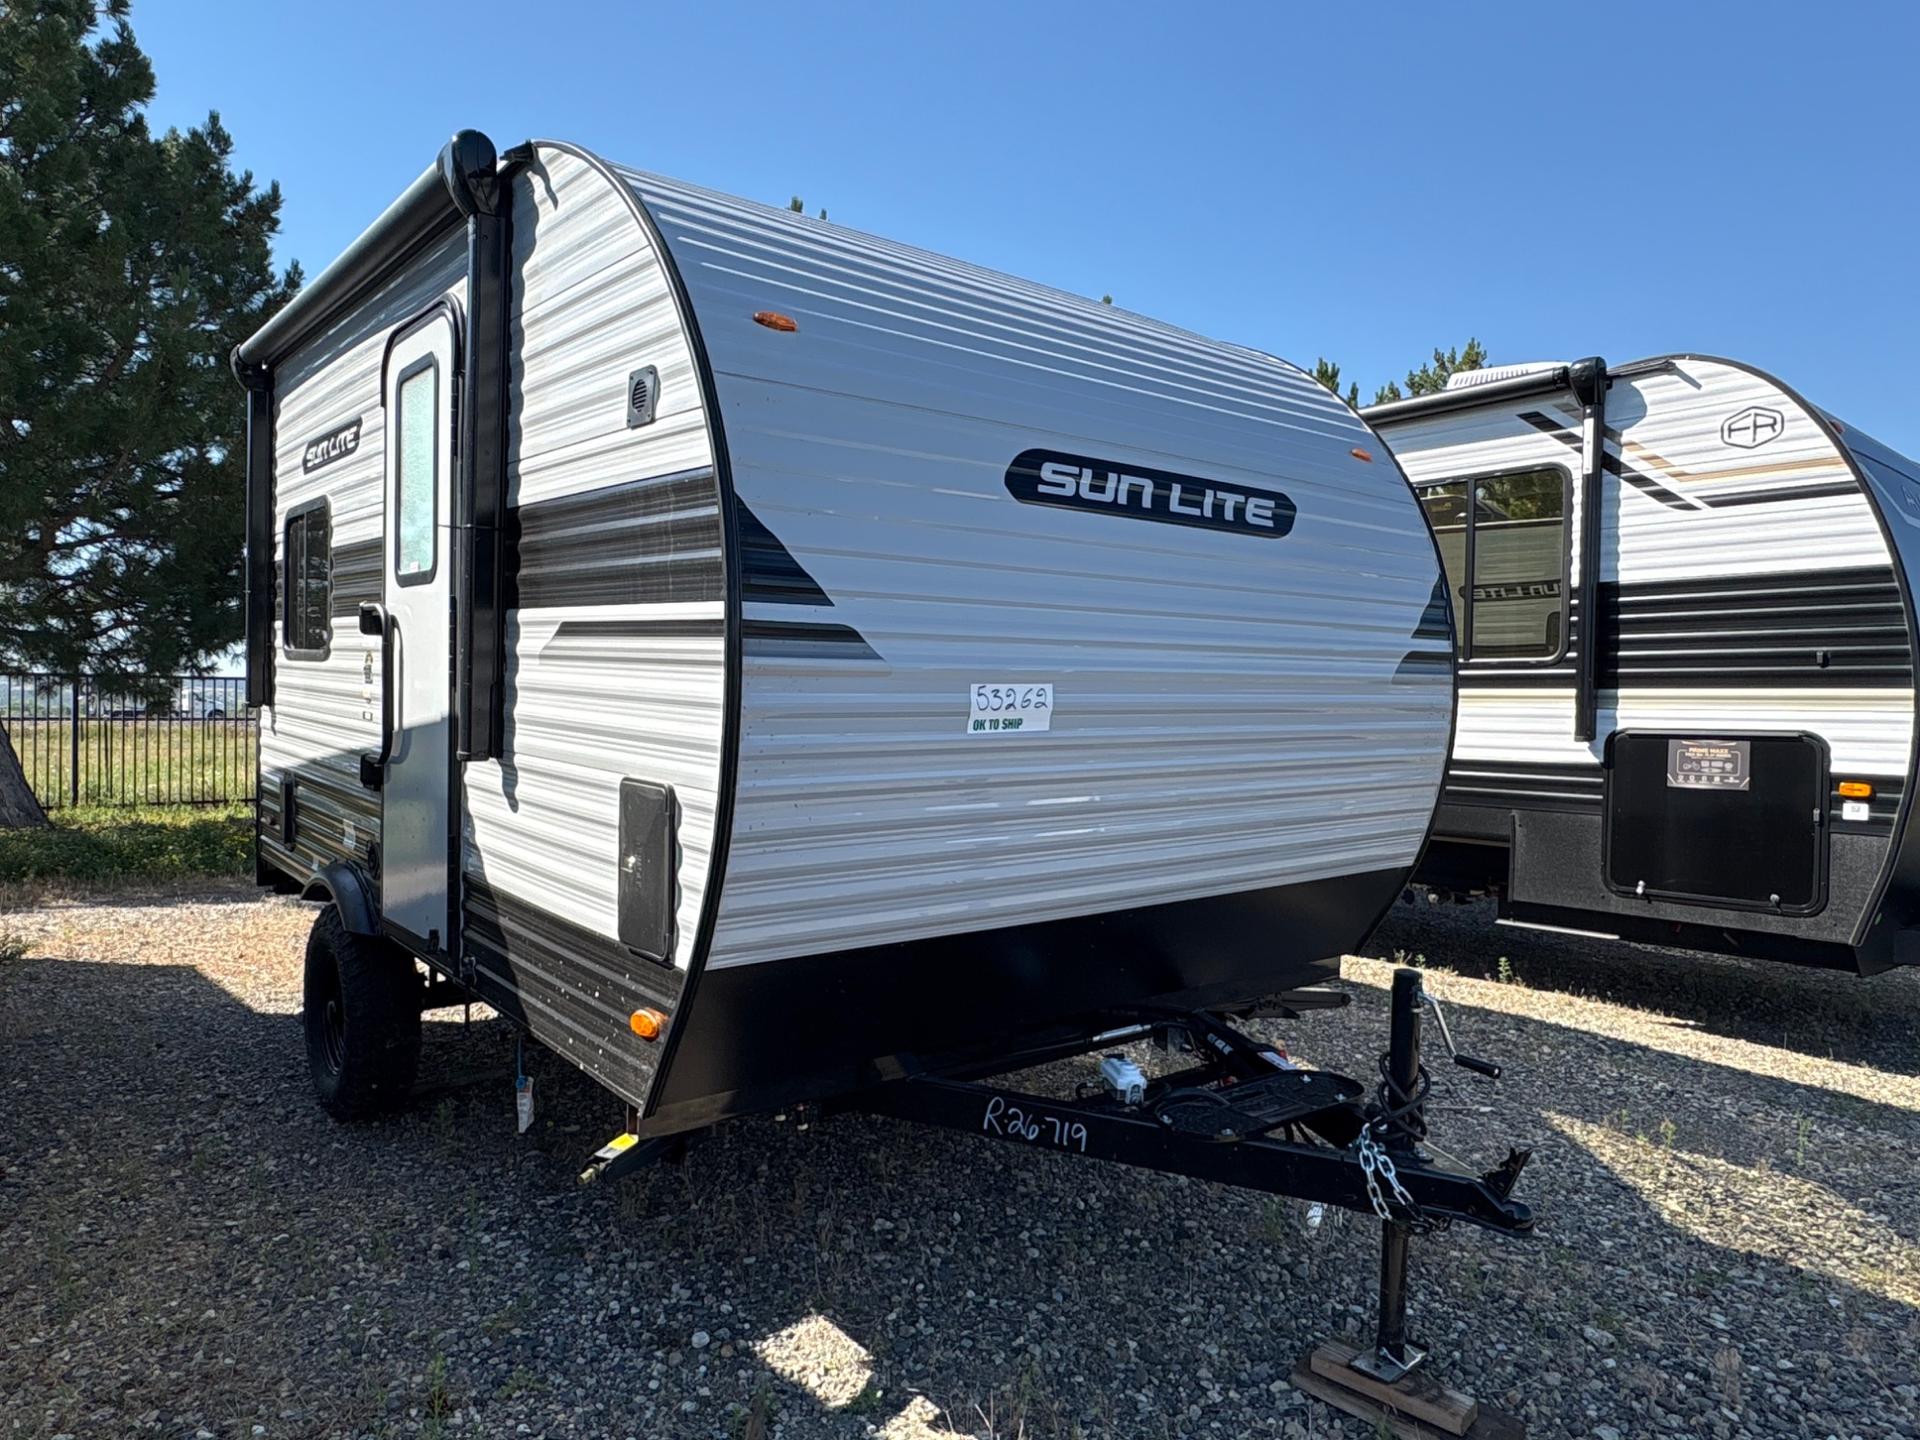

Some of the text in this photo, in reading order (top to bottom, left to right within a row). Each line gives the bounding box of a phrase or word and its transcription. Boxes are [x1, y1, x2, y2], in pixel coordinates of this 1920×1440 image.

[1037, 461, 1276, 527] SUN LITE
[975, 684, 1049, 712] 53262
[972, 718, 1024, 731] OK TO SHIP
